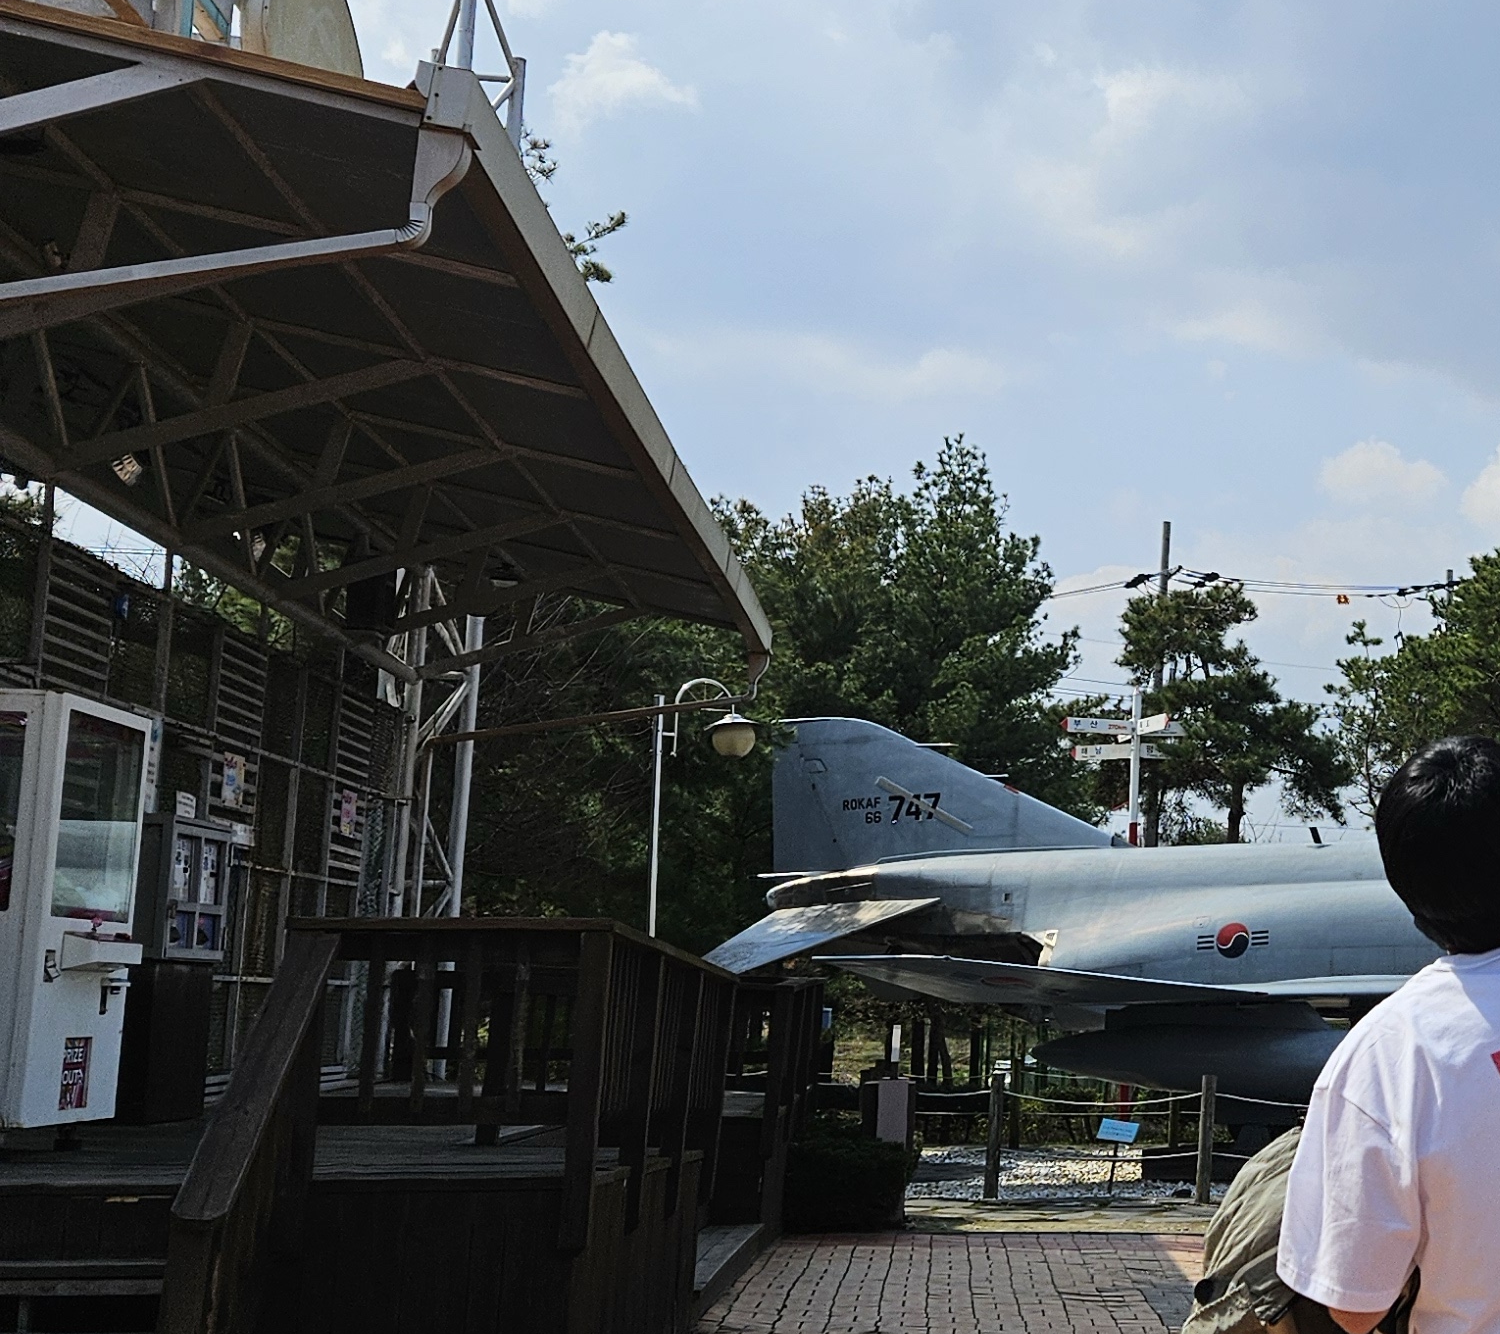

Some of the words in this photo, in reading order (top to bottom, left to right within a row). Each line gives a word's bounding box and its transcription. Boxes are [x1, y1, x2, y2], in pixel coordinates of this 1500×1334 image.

[842, 797, 881, 811] ROKAF
[888, 792, 941, 825] 747
[865, 811, 882, 824] 66
